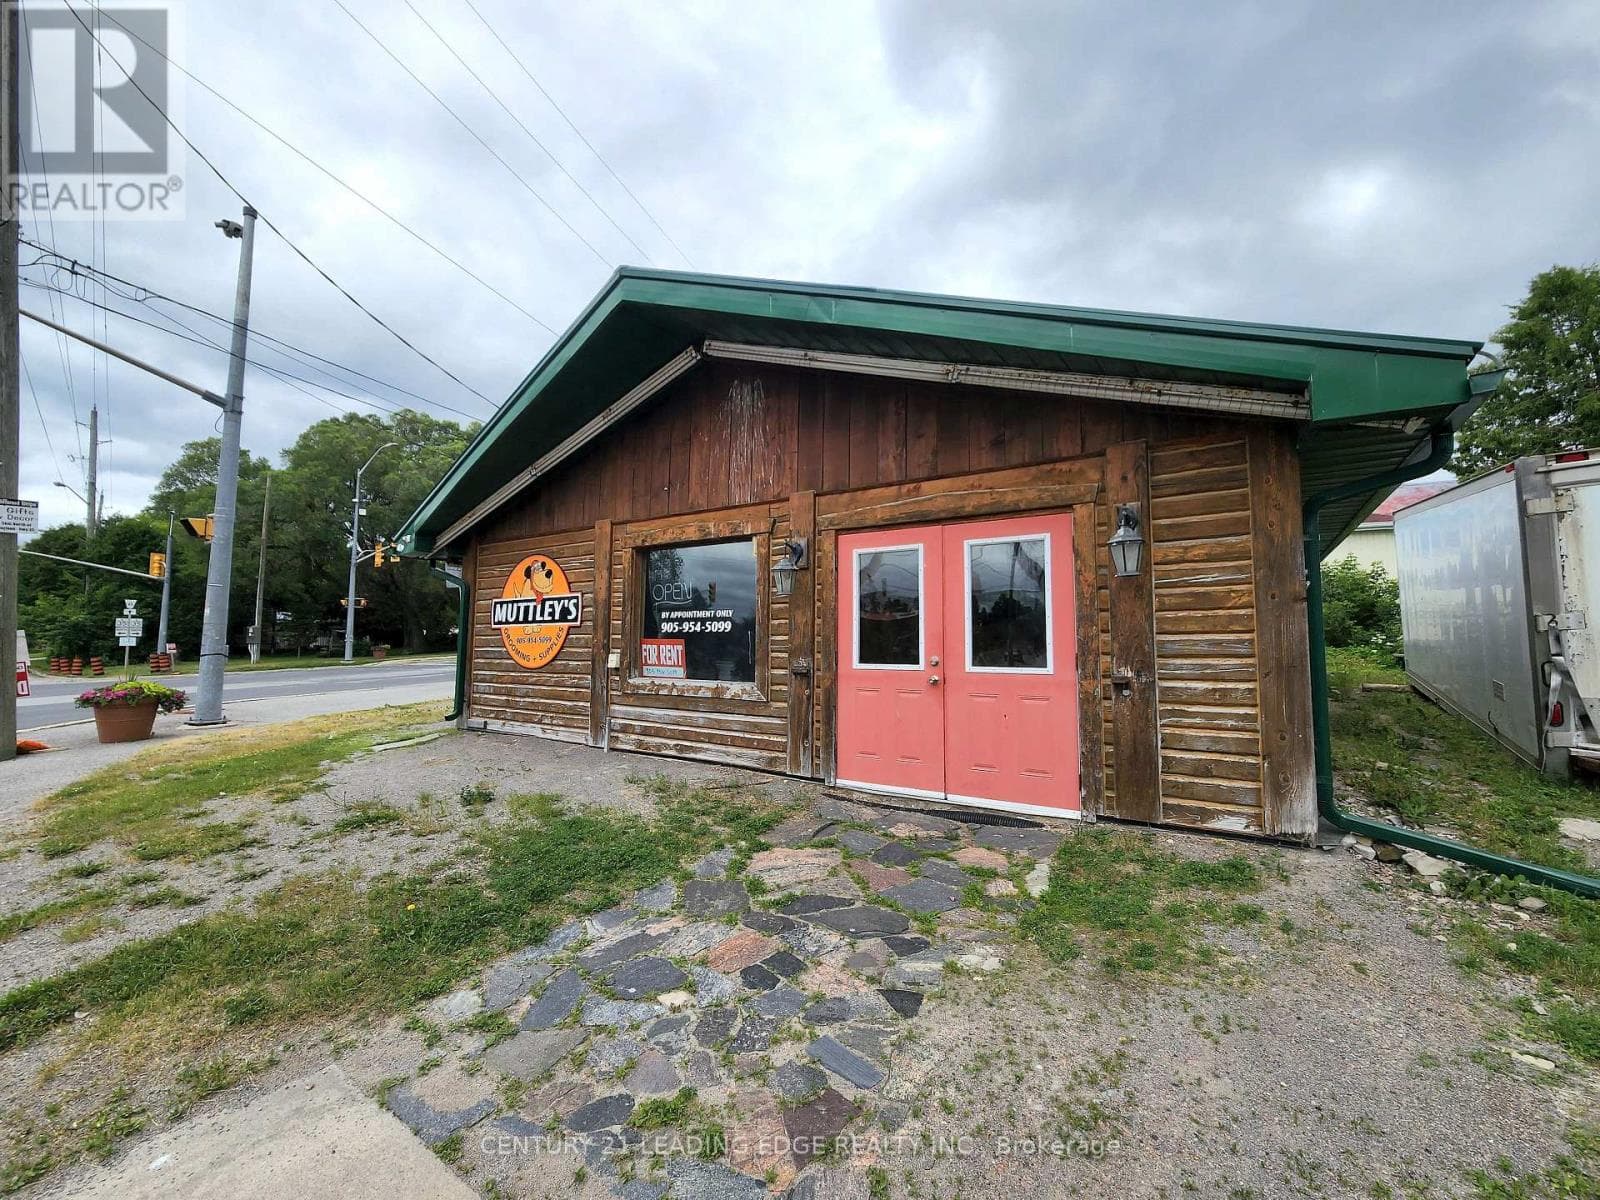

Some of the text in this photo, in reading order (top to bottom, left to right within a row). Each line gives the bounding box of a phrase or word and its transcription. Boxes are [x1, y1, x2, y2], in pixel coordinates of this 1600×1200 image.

[6, 507, 34, 515] Gifts
[652, 581, 693, 601] OPEN
[494, 599, 578, 623] MUTTLEY'S
[661, 609, 734, 619] BY APPOINTMENT ONLY
[661, 621, 732, 633] 905-954-5099
[503, 627, 531, 662] GROOMING
[538, 626, 564, 660] SUPPLIES
[642, 644, 683, 666] FOR RENT
